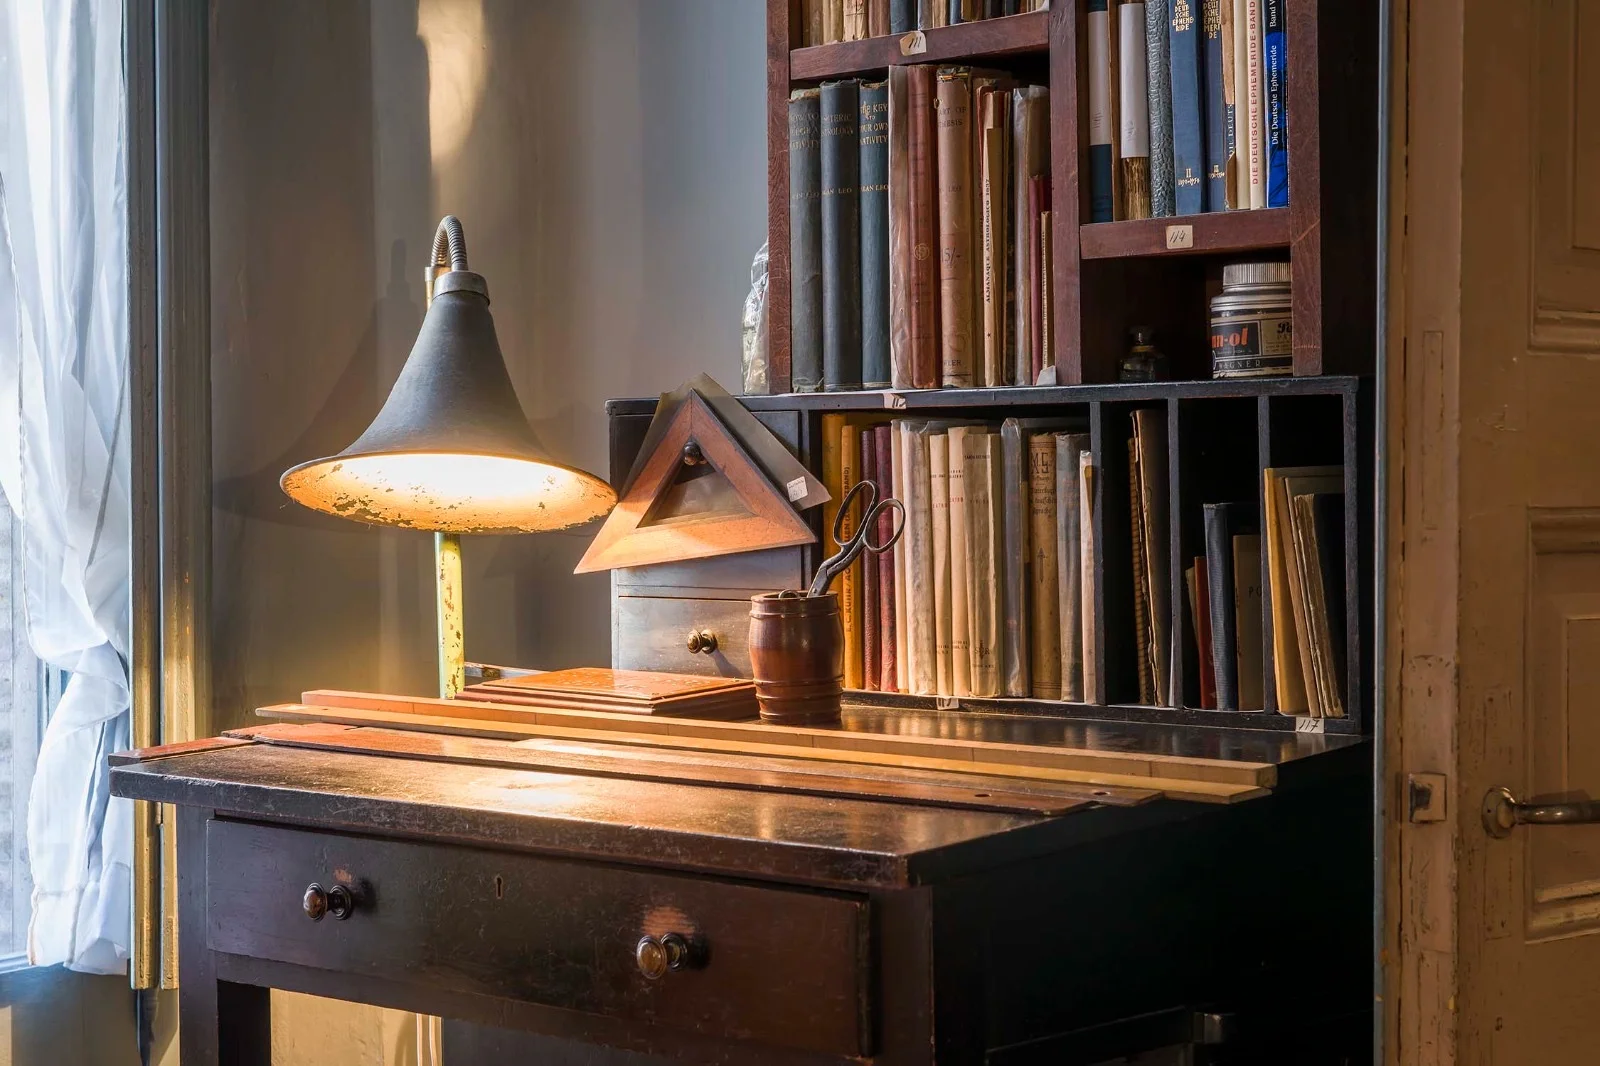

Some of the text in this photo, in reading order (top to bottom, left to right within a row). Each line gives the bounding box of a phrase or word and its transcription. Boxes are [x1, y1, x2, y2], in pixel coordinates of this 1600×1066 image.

[1269, 6, 1277, 27] Band
[1209, 31, 1217, 39] DE
[1269, 45, 1279, 145] Die Deutsche Ephemeride
[873, 103, 888, 113] KEY
[1170, 230, 1186, 243] 114
[1299, 719, 1319, 732] 117
